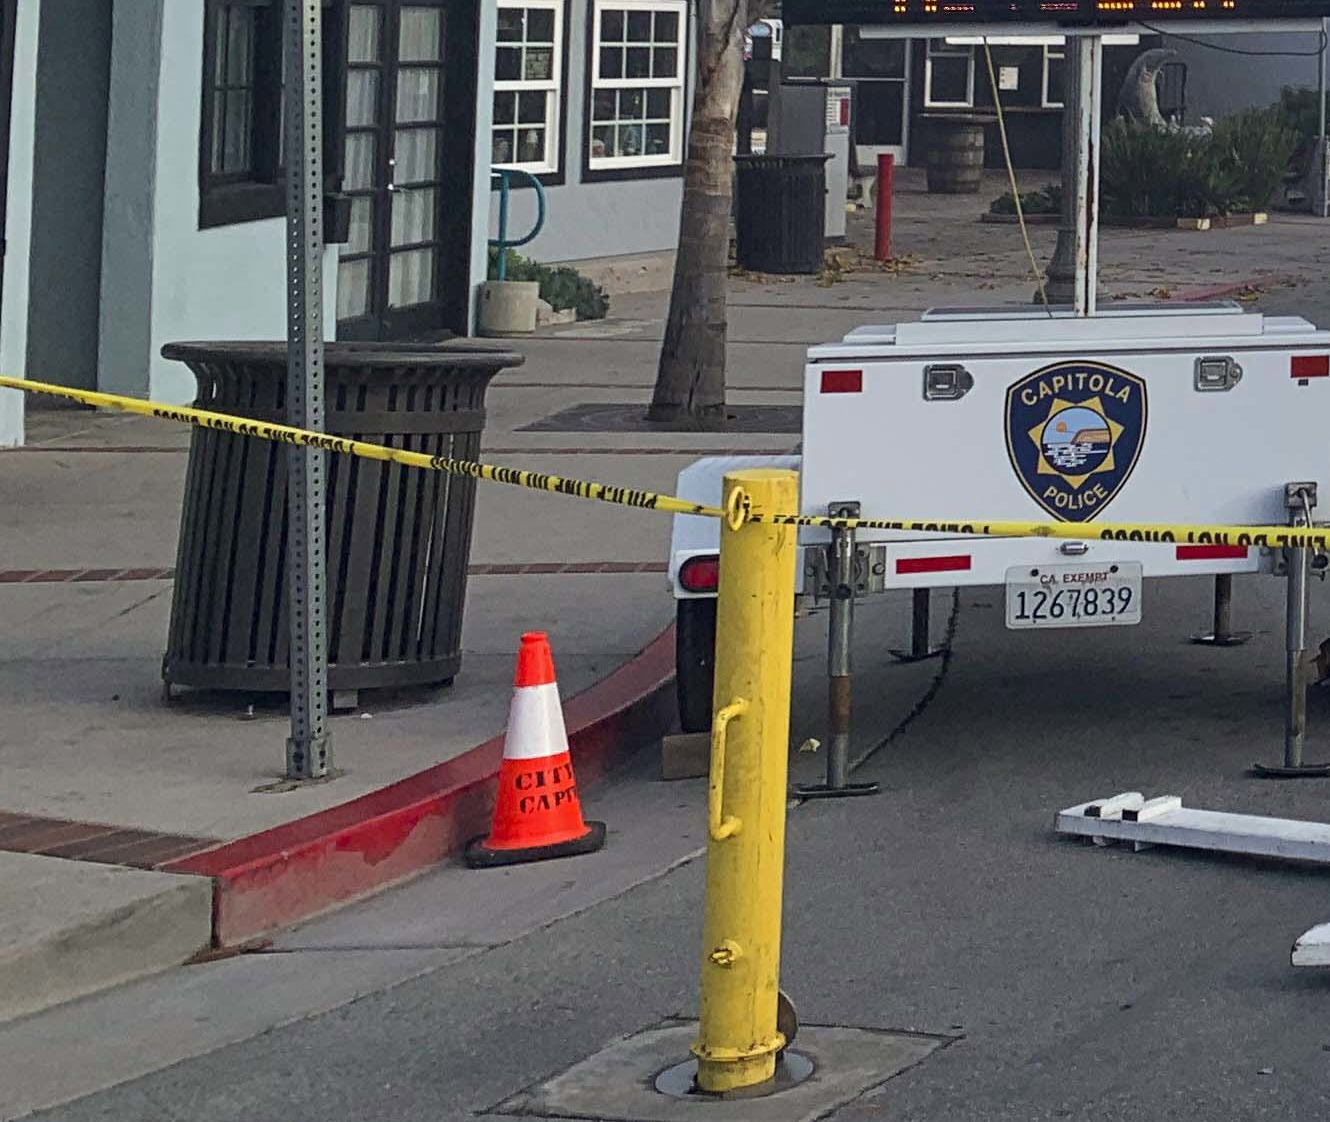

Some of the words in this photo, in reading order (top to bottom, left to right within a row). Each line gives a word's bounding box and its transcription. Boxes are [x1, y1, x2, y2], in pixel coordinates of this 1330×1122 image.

[1021, 373, 1131, 405] CAPITOLA
[1044, 483, 1109, 510] POLICE
[1015, 586, 1133, 620] 1267839
